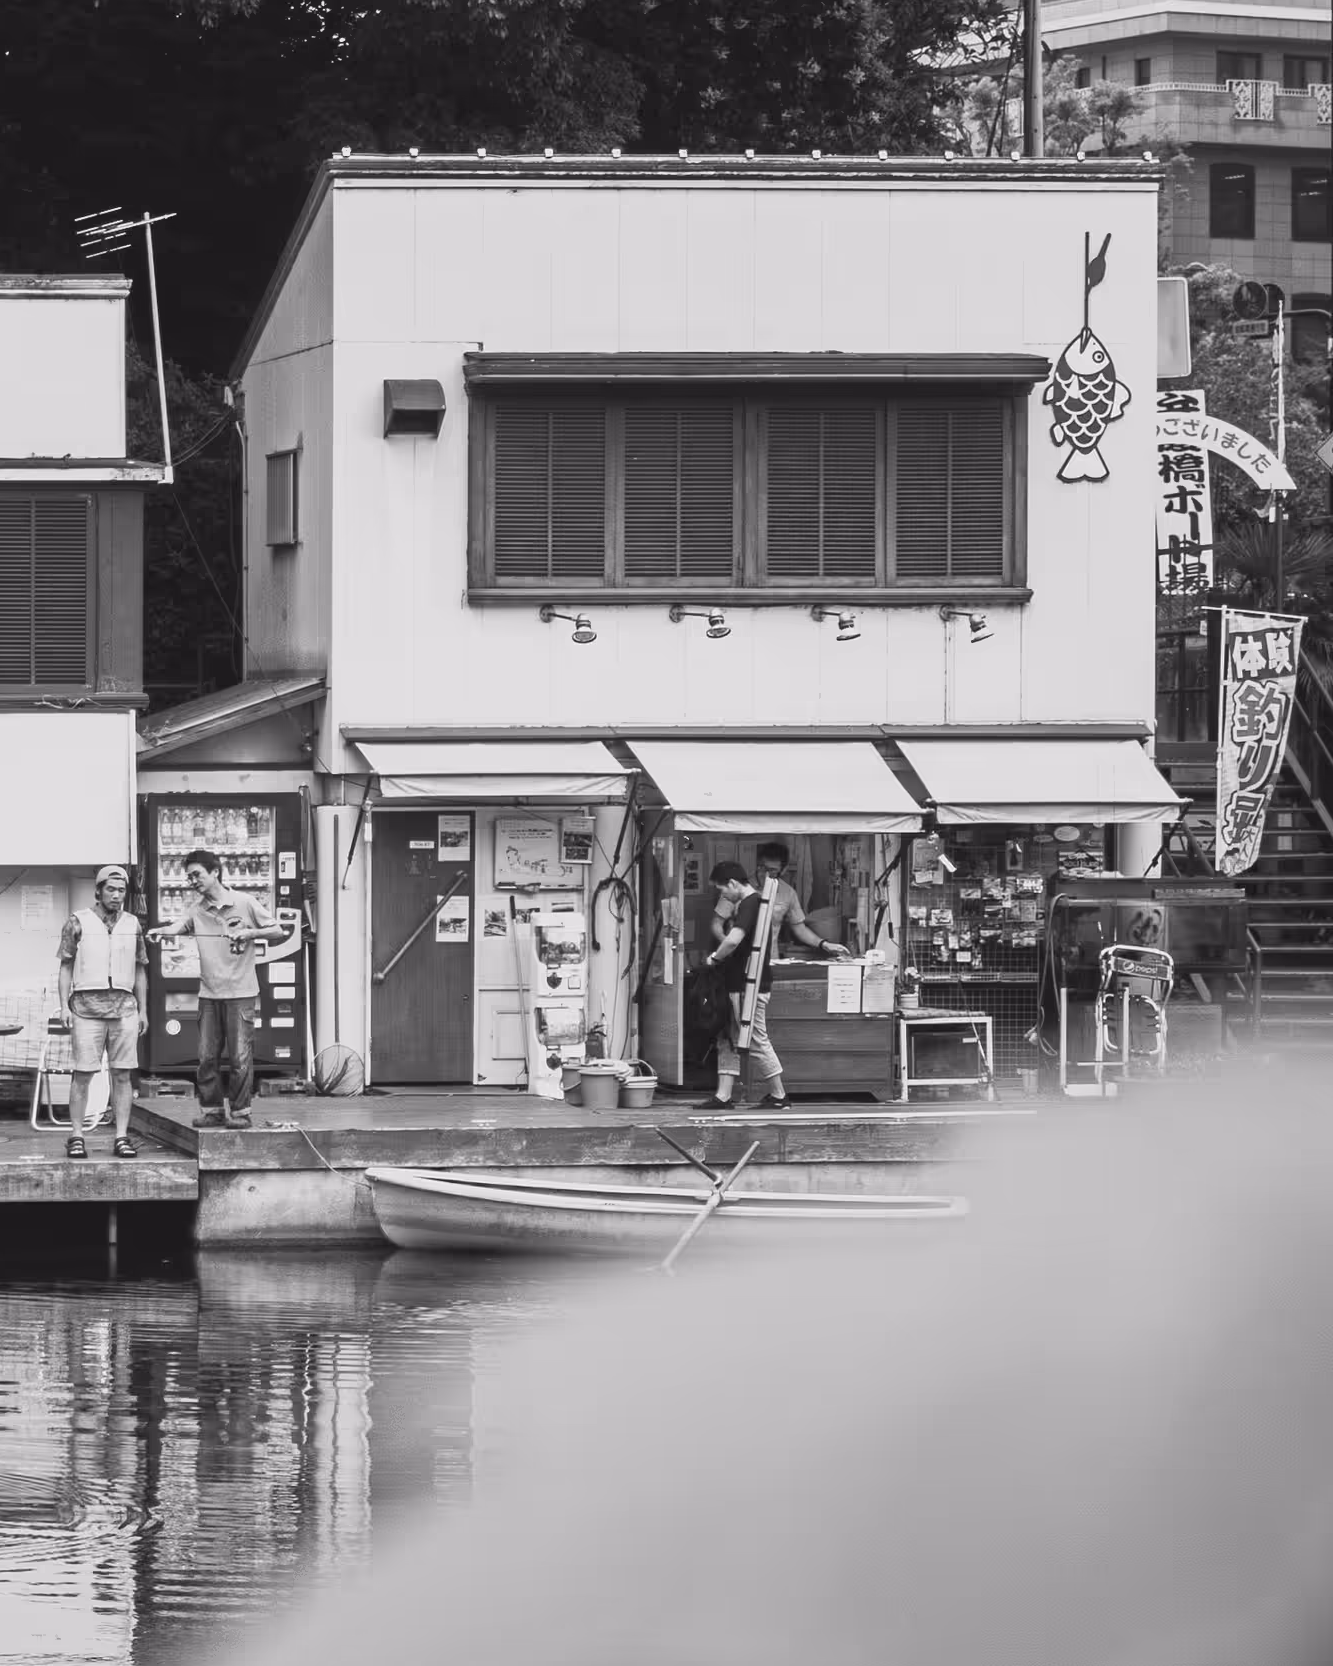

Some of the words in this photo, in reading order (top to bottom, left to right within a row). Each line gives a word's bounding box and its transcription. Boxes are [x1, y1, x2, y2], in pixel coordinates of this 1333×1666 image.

[1156, 393, 1209, 589] 弁橋ボート場
